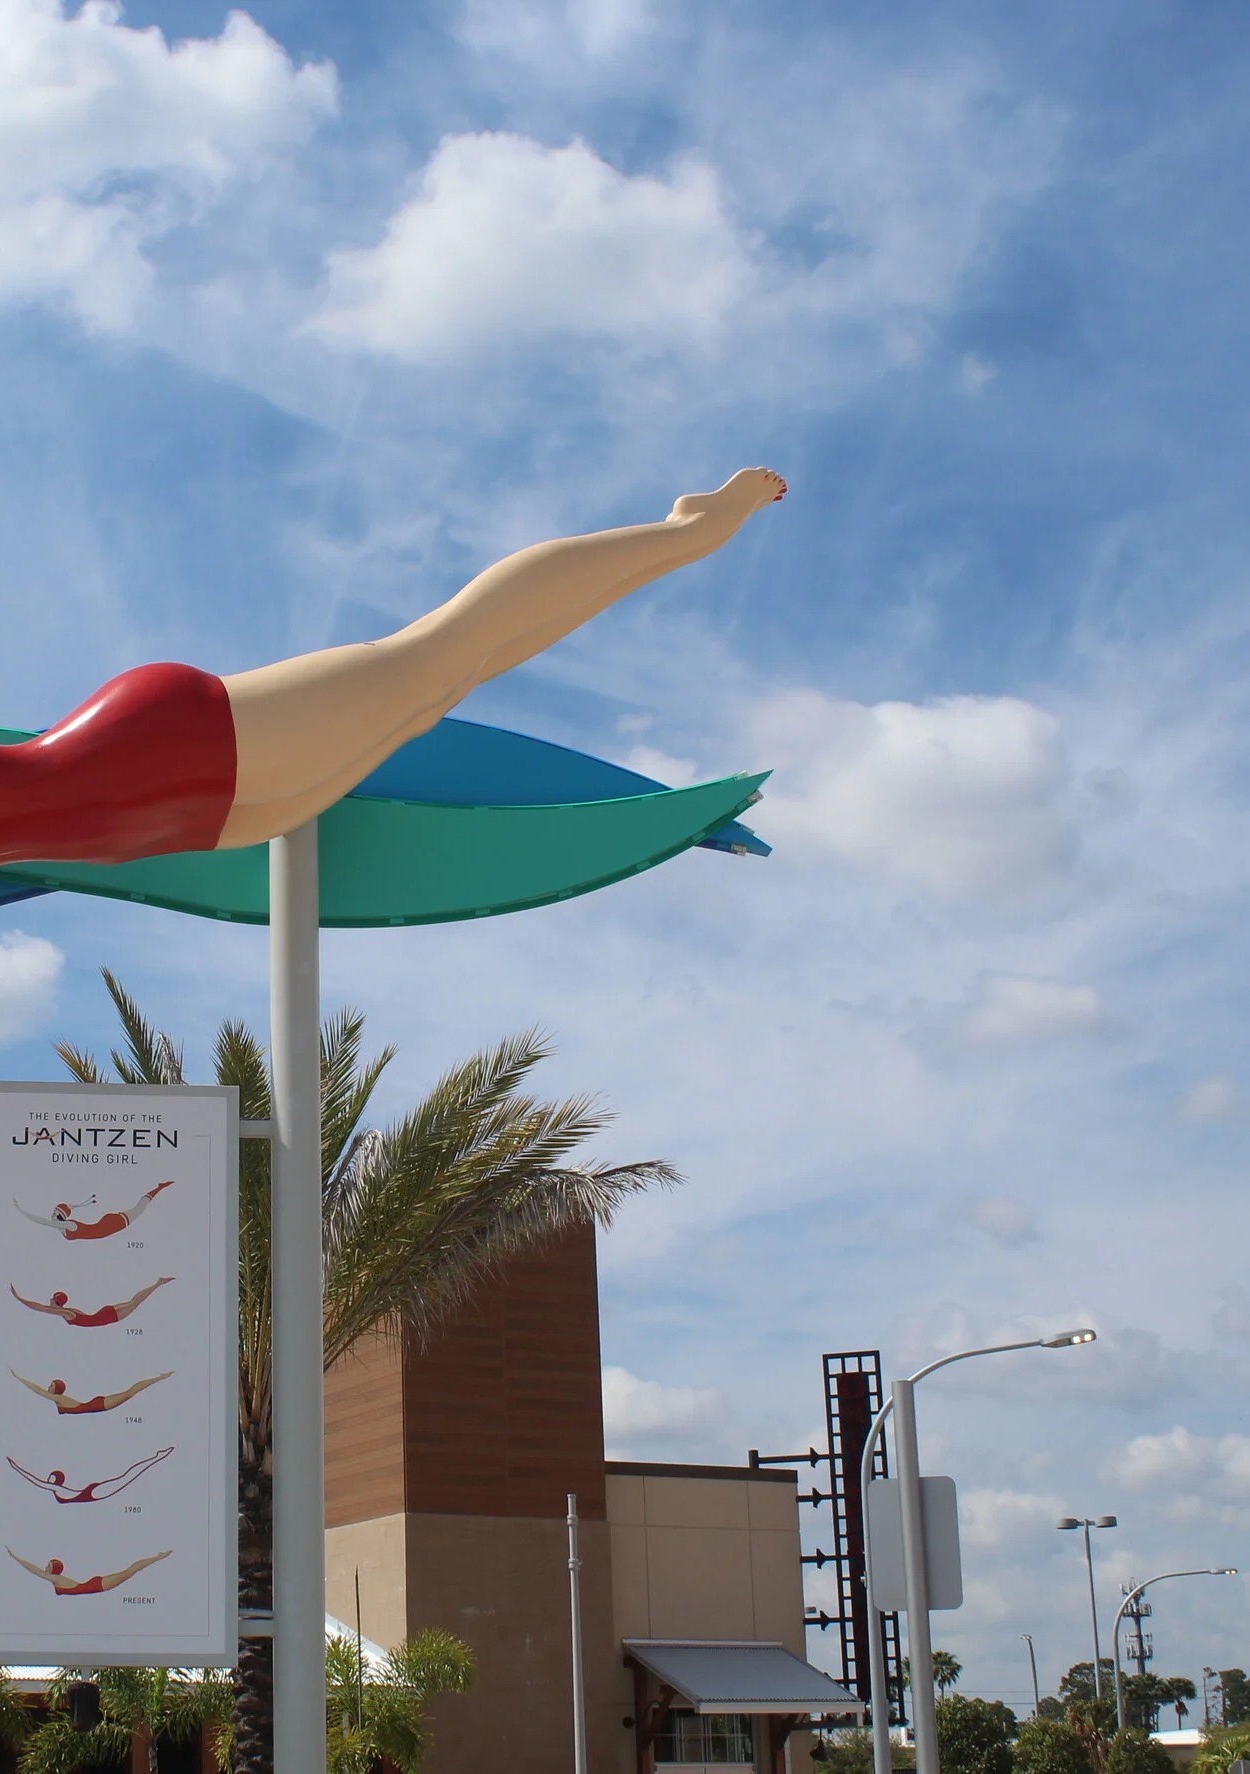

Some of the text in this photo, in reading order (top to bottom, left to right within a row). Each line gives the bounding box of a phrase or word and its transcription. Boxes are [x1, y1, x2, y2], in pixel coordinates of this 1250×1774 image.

[29, 1112, 162, 1123] THE EVOLUTION OF THE
[12, 1127, 178, 1149] JANTZEN
[52, 1153, 138, 1165] DIVING GIRL
